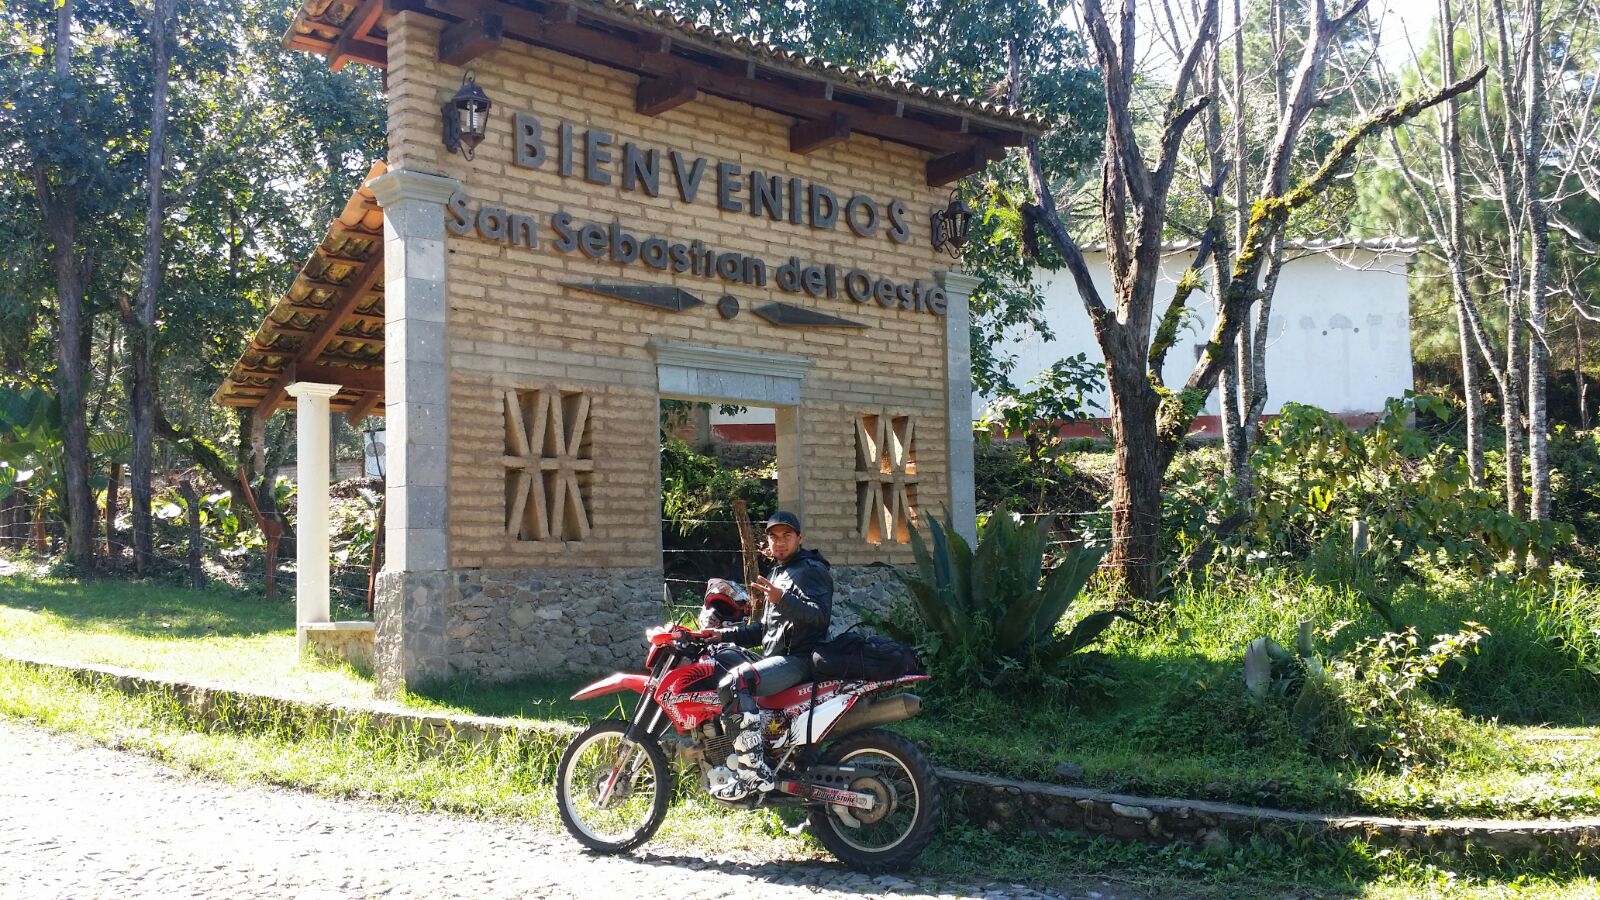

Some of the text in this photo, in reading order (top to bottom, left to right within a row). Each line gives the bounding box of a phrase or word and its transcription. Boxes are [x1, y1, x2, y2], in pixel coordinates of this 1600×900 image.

[513, 112, 909, 244] BIENVENIDOS
[447, 190, 948, 316] San Sebastian del Oeste
